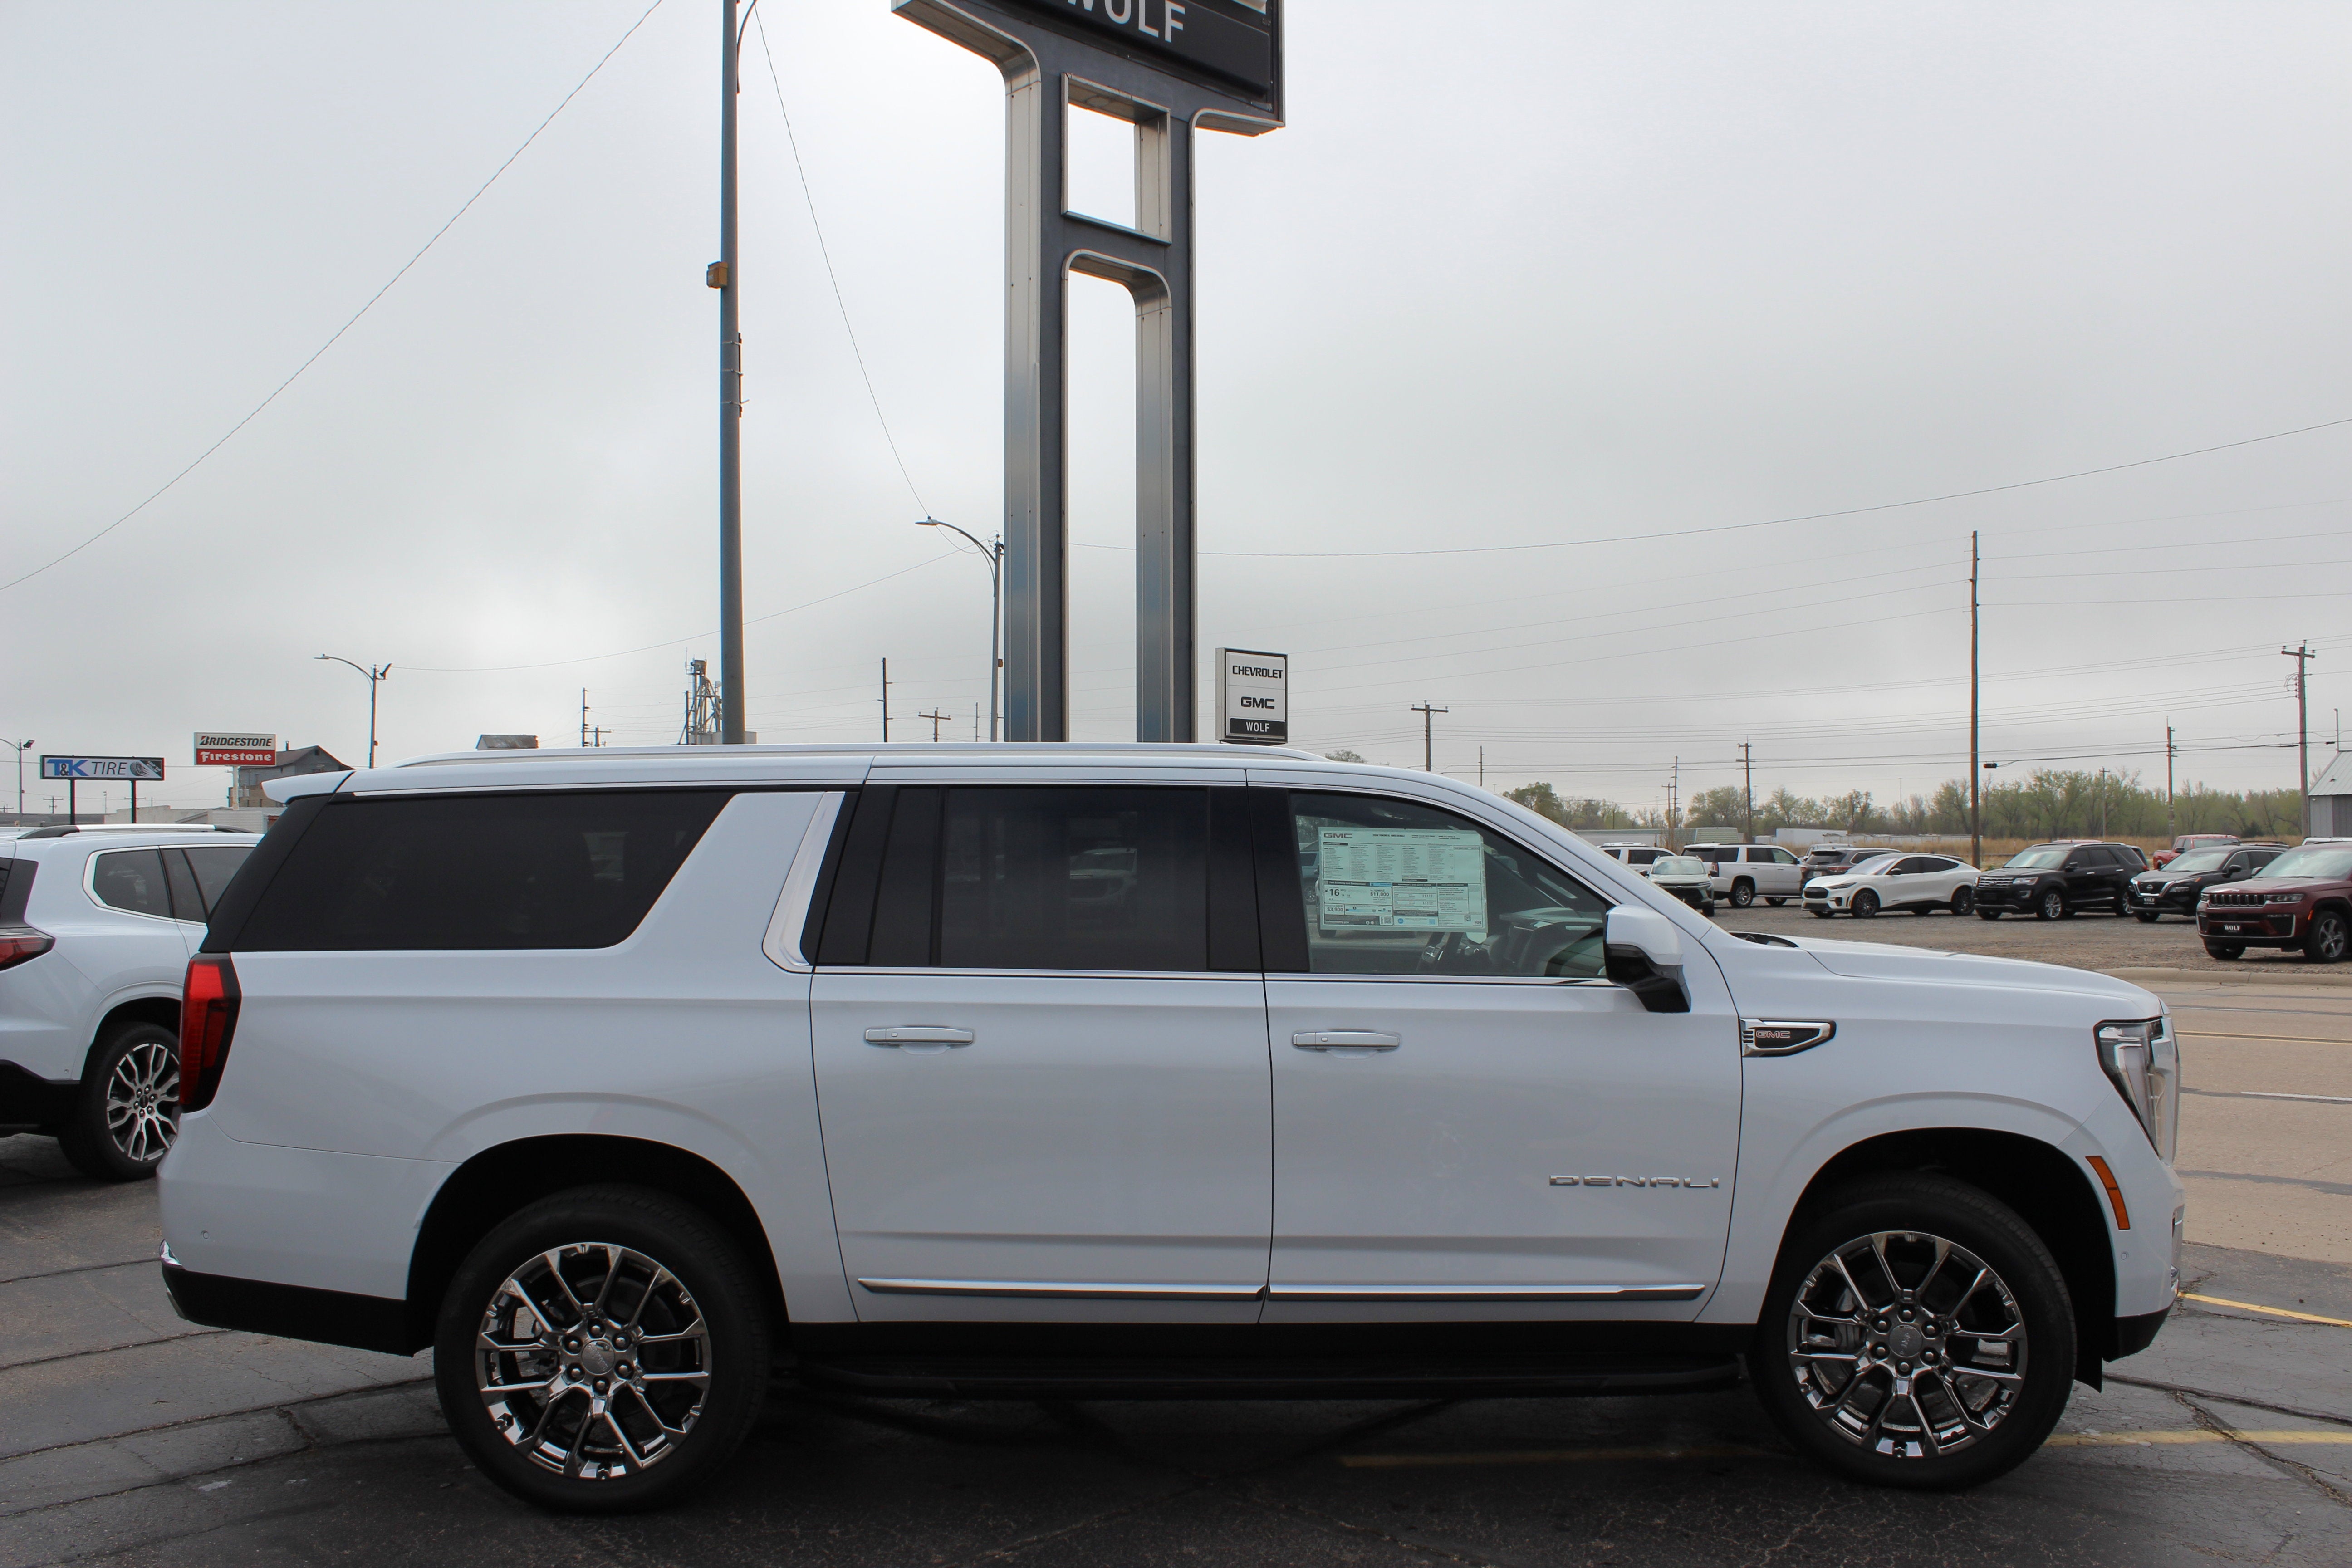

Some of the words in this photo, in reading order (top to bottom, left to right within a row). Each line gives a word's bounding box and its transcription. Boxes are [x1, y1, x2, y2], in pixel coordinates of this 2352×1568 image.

[1068, 0, 1186, 43] OLF
[1232, 665, 1283, 679] CHEVROLET
[1241, 696, 1275, 709] GMC
[1246, 721, 1270, 732] WOLF
[200, 736, 272, 746] BRIDGESTONE
[200, 751, 272, 763] Firestone
[46, 759, 89, 776] T&K
[92, 761, 127, 775] TIRE
[1756, 1030, 1790, 1039] GMC
[1549, 1174, 1719, 1188] DENALI
